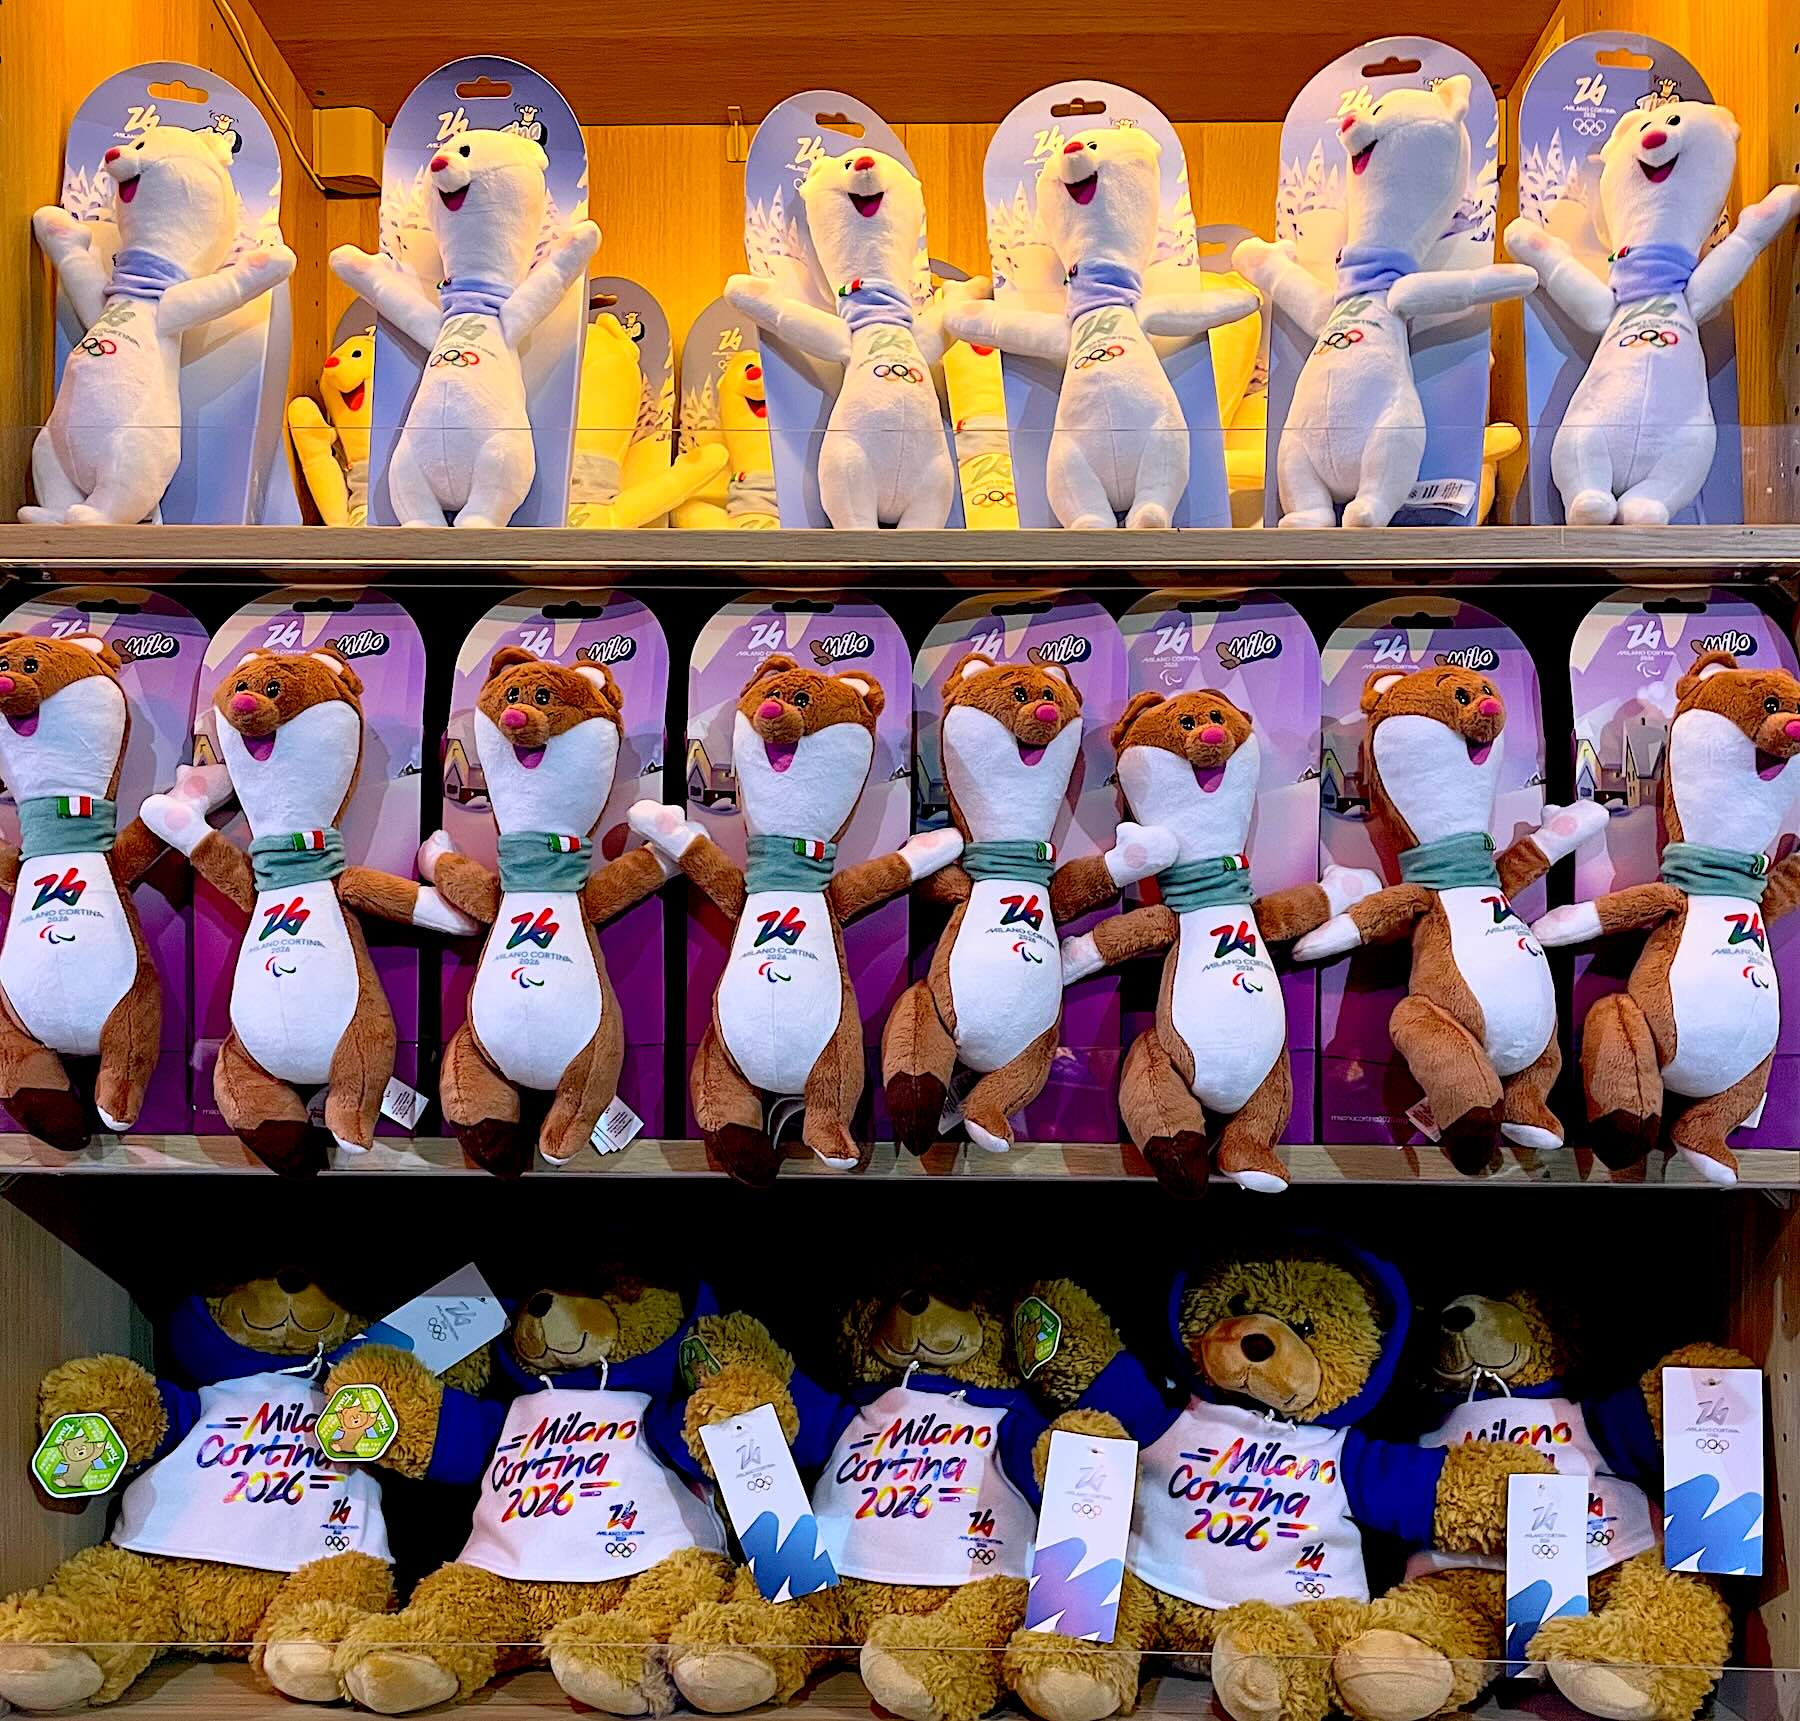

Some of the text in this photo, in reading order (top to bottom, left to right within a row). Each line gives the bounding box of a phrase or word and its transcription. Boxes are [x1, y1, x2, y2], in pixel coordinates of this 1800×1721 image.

[1573, 73, 1608, 106] 26
[718, 327, 742, 351] 26
[263, 620, 301, 648] 26
[747, 620, 784, 649] 26
[1154, 622, 1190, 655] 26
[1373, 635, 1407, 663] 26
[1627, 620, 1661, 649] 26
[32, 868, 87, 911] 26
[58, 908, 104, 919] CORTINA
[259, 897, 311, 942] 26
[506, 908, 560, 950] 26
[754, 907, 807, 948] 26
[984, 926, 1026, 934] MILANO
[1000, 895, 1044, 931] 26
[280, 938, 326, 949] CORTINA
[1210, 920, 1256, 959] 26
[1724, 912, 1765, 952] 26
[493, 951, 574, 964] MILANO CORTINA
[739, 947, 819, 961] MILANO CORTINA
[1201, 959, 1243, 973] MILANO
[243, 1402, 319, 1440] Mila
[1696, 1397, 1729, 1426] 26
[520, 1412, 637, 1458] Milano
[873, 1413, 992, 1456] Milano
[492, 1445, 610, 1492] Cortina
[836, 1447, 967, 1484] Cortina
[1209, 1437, 1336, 1484] Milano
[222, 1471, 305, 1505] 2026
[501, 1480, 575, 1523] 2026
[855, 1483, 934, 1519] 2026
[1168, 1464, 1310, 1518] Cortina
[608, 1500, 638, 1530] 26
[968, 1508, 996, 1537] 26
[1185, 1508, 1271, 1552] 2026
[1295, 1542, 1325, 1571] 26
